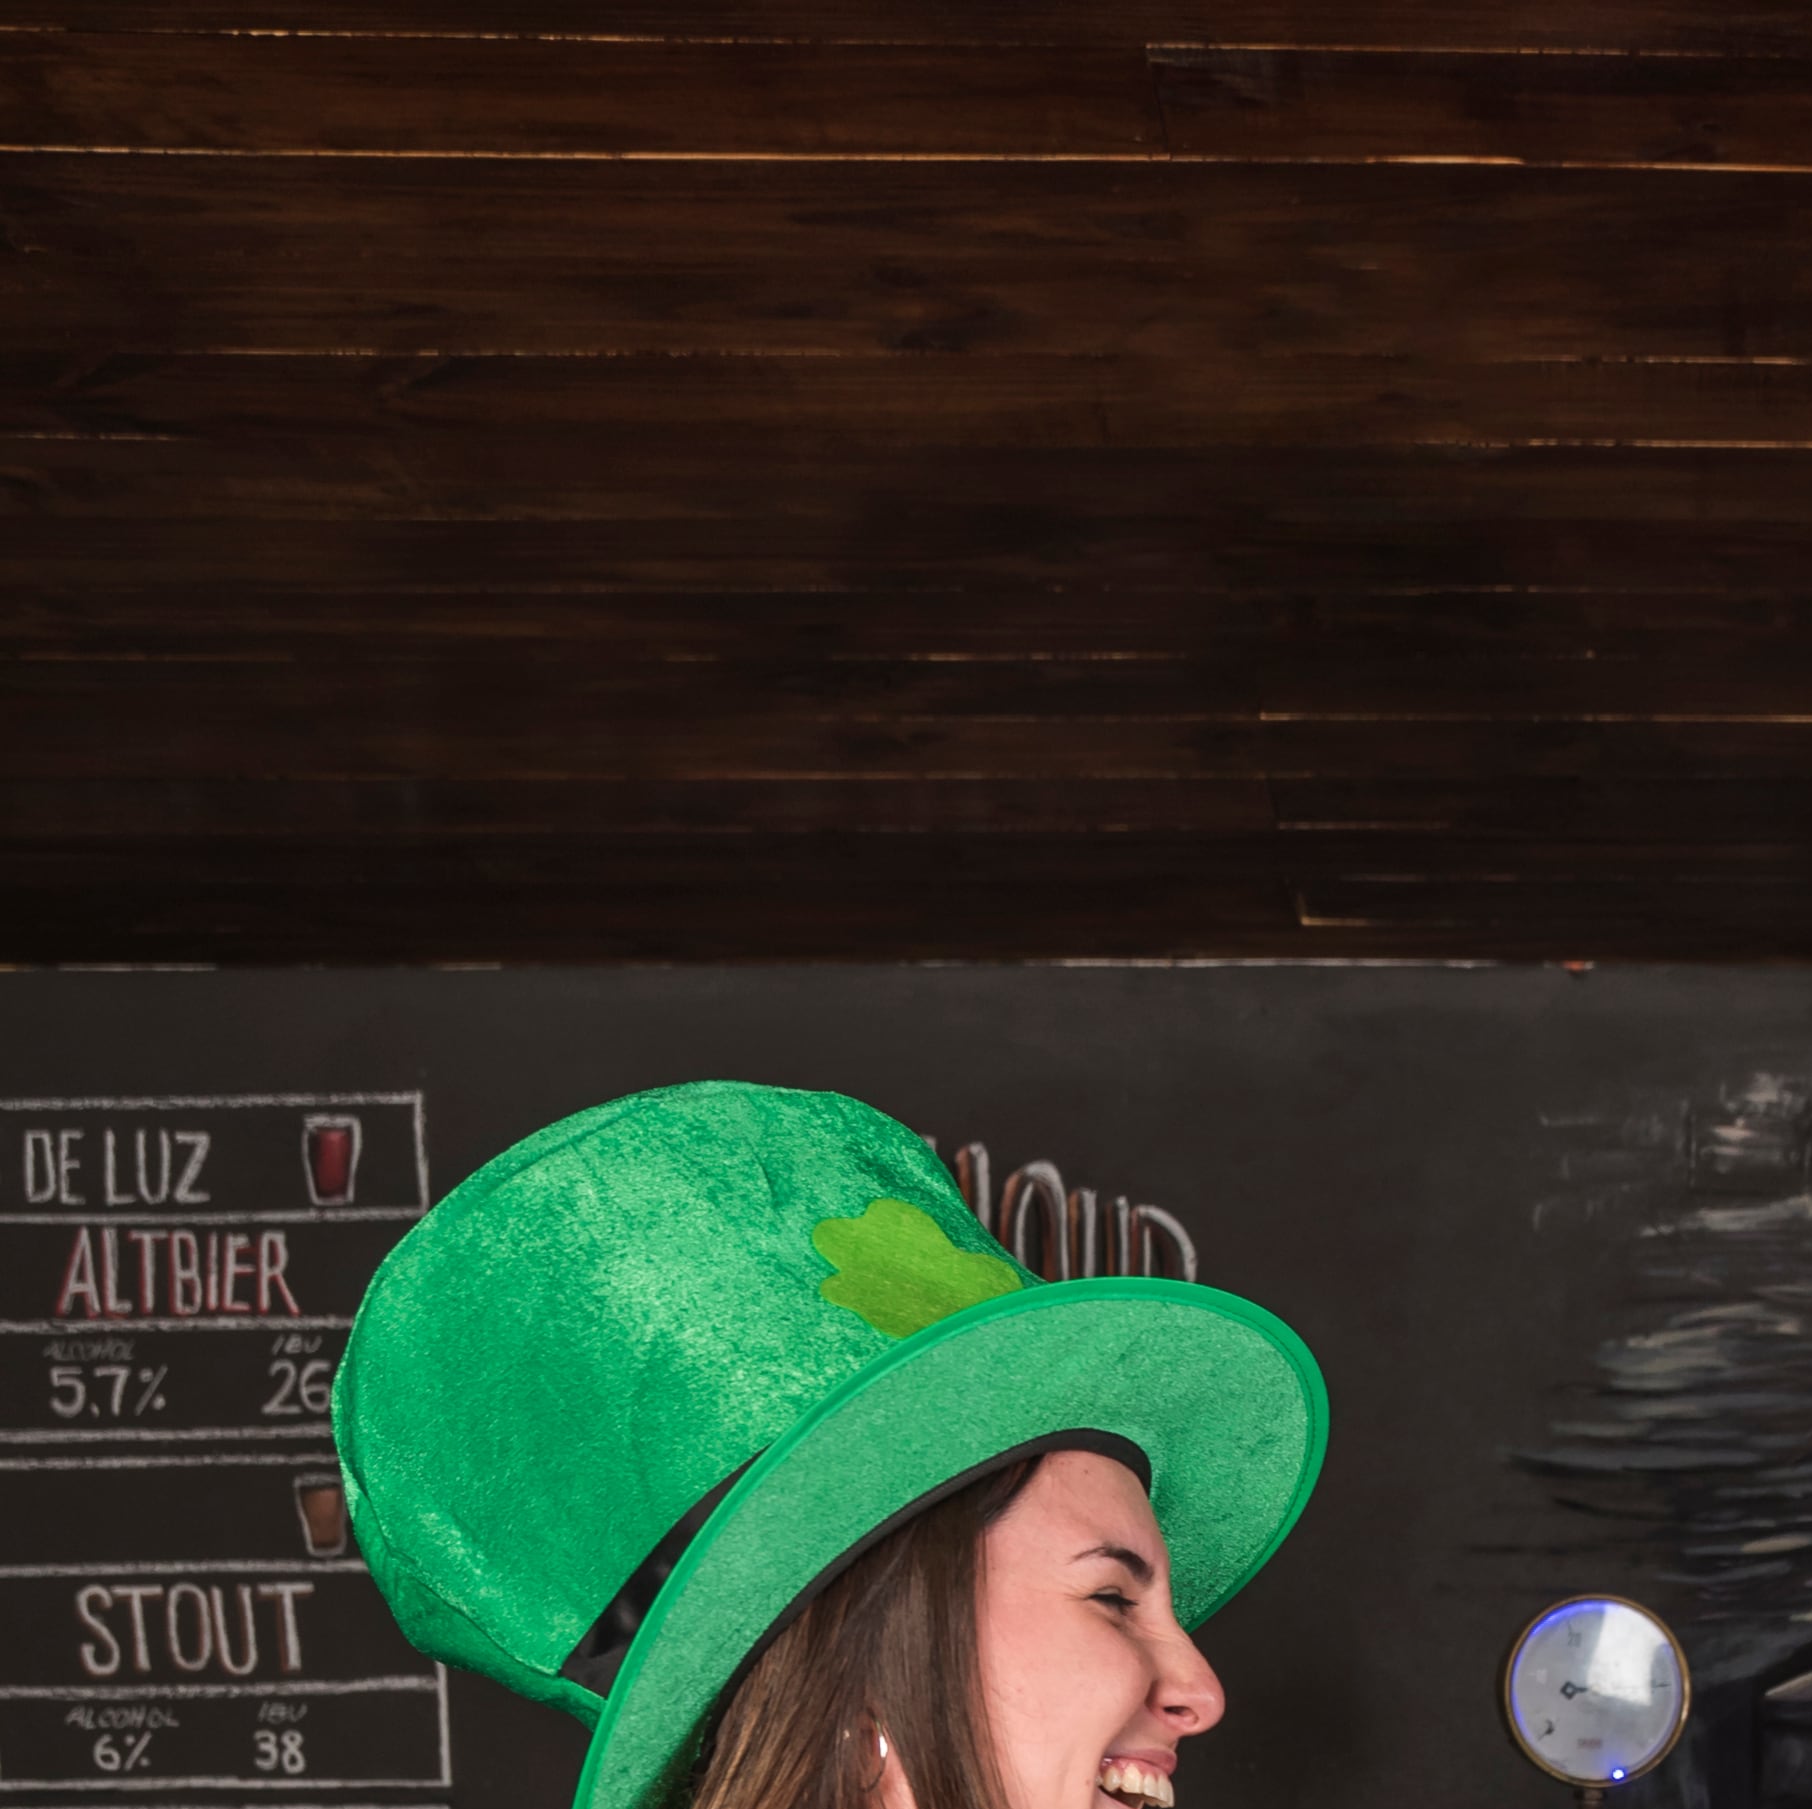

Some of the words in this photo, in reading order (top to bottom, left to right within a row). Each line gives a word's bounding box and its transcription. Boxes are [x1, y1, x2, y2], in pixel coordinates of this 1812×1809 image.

[24, 1130, 85, 1205] DE
[104, 1129, 211, 1204] LUZ
[56, 1226, 300, 1319] ALTBIER
[261, 1359, 330, 1415] 26
[76, 1583, 314, 1676] STOUT
[94, 1731, 151, 1771] 6%
[253, 1729, 306, 1774] 38
